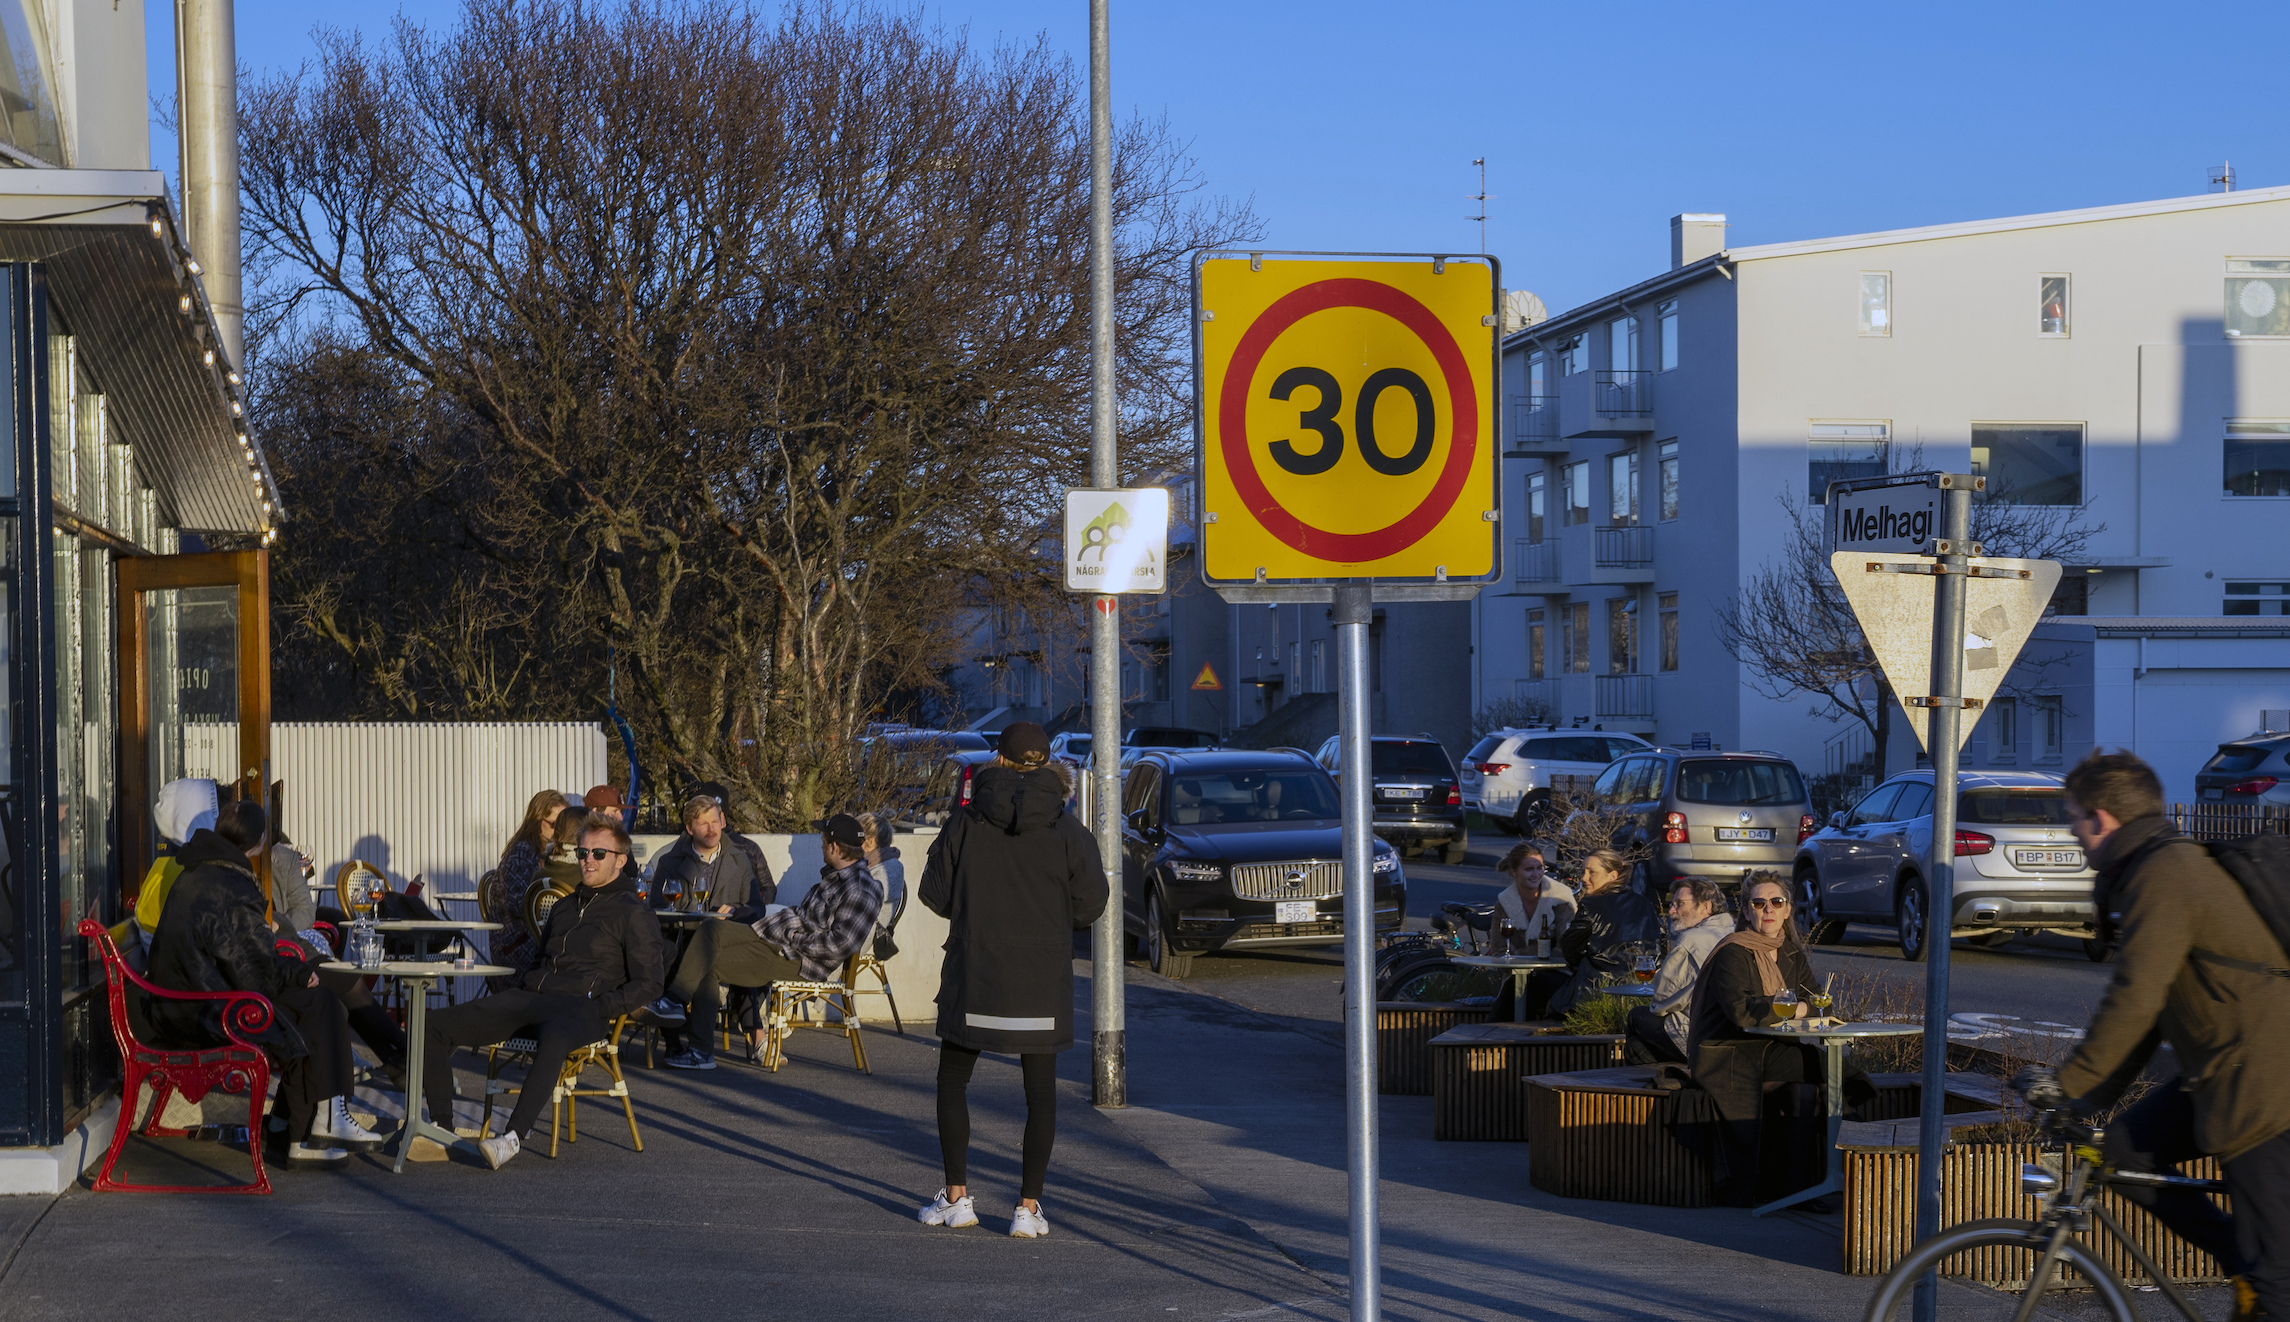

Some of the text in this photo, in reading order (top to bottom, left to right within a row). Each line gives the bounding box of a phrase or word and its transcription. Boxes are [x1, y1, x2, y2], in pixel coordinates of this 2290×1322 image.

[1268, 366, 1435, 476] 30
[1843, 502, 1933, 545] Melhagi
[1727, 830, 1768, 838] JY D47
[2026, 852, 2044, 862] BP
[2054, 852, 2075, 862] B17
[1286, 903, 1301, 912] FE
